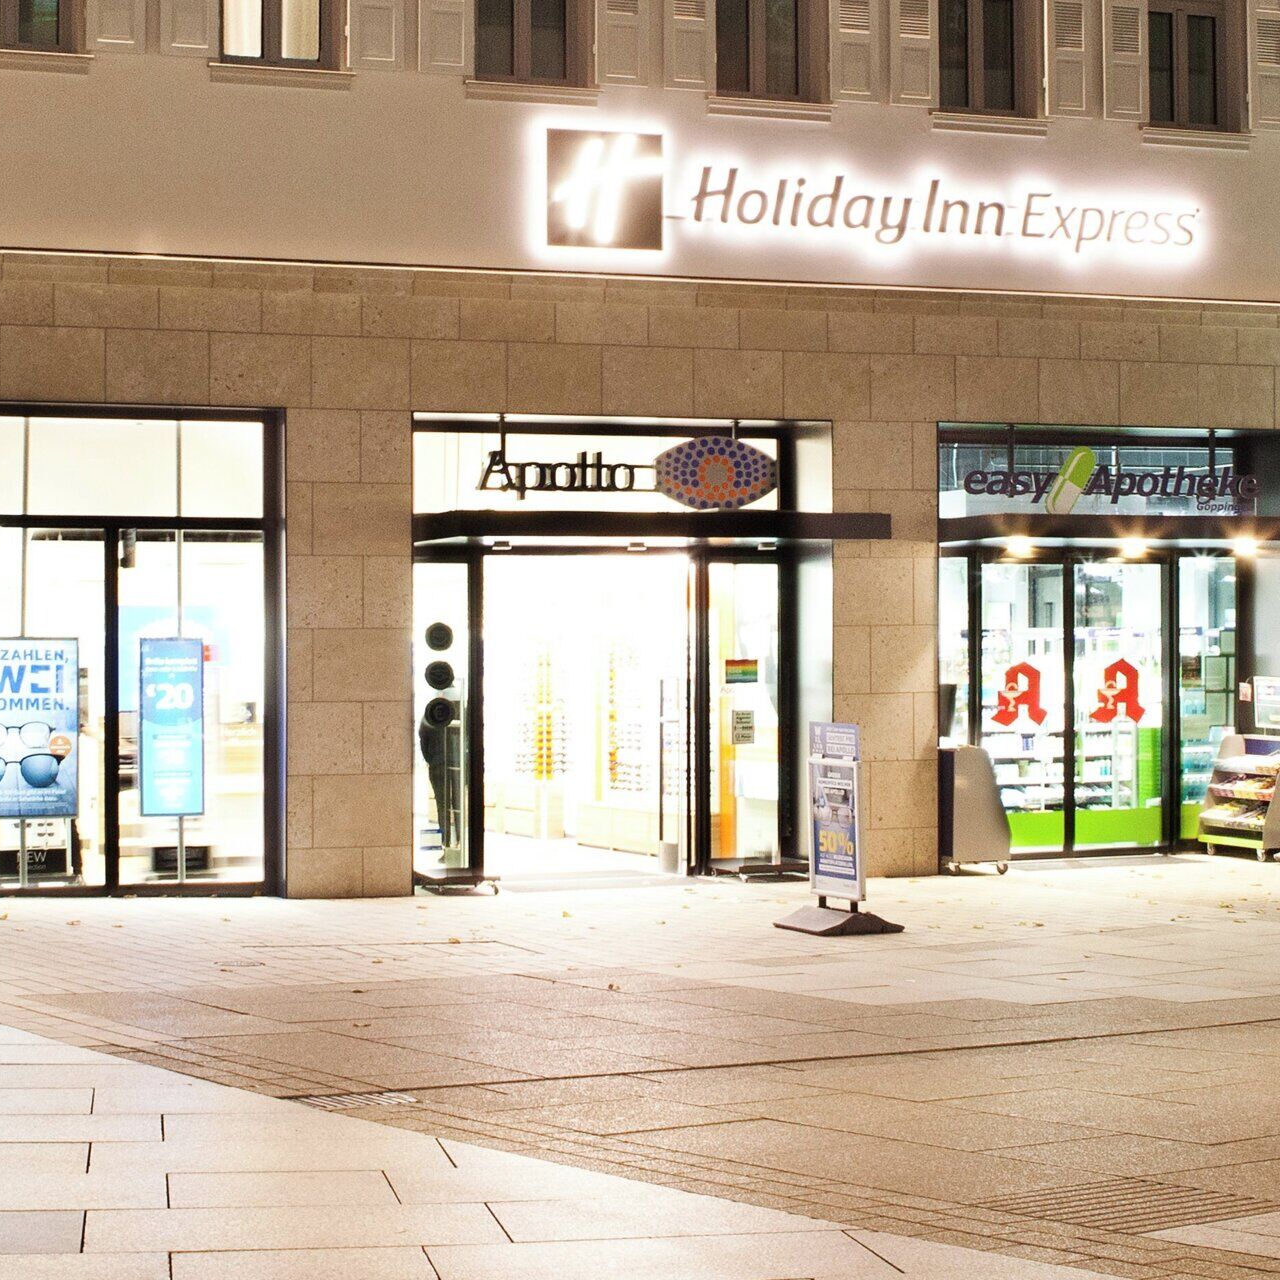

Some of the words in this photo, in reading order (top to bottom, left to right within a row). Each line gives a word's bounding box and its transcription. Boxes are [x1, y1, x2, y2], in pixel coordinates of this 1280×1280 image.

[690, 166, 912, 246] Holiday
[924, 178, 1006, 239] Inn
[1021, 192, 1199, 254] Express
[475, 450, 636, 501] Apollo
[963, 469, 1054, 505] easy
[1084, 464, 1264, 506] Apotheke
[0, 649, 69, 664] ZAHLEN,
[818, 829, 855, 856] 50%
